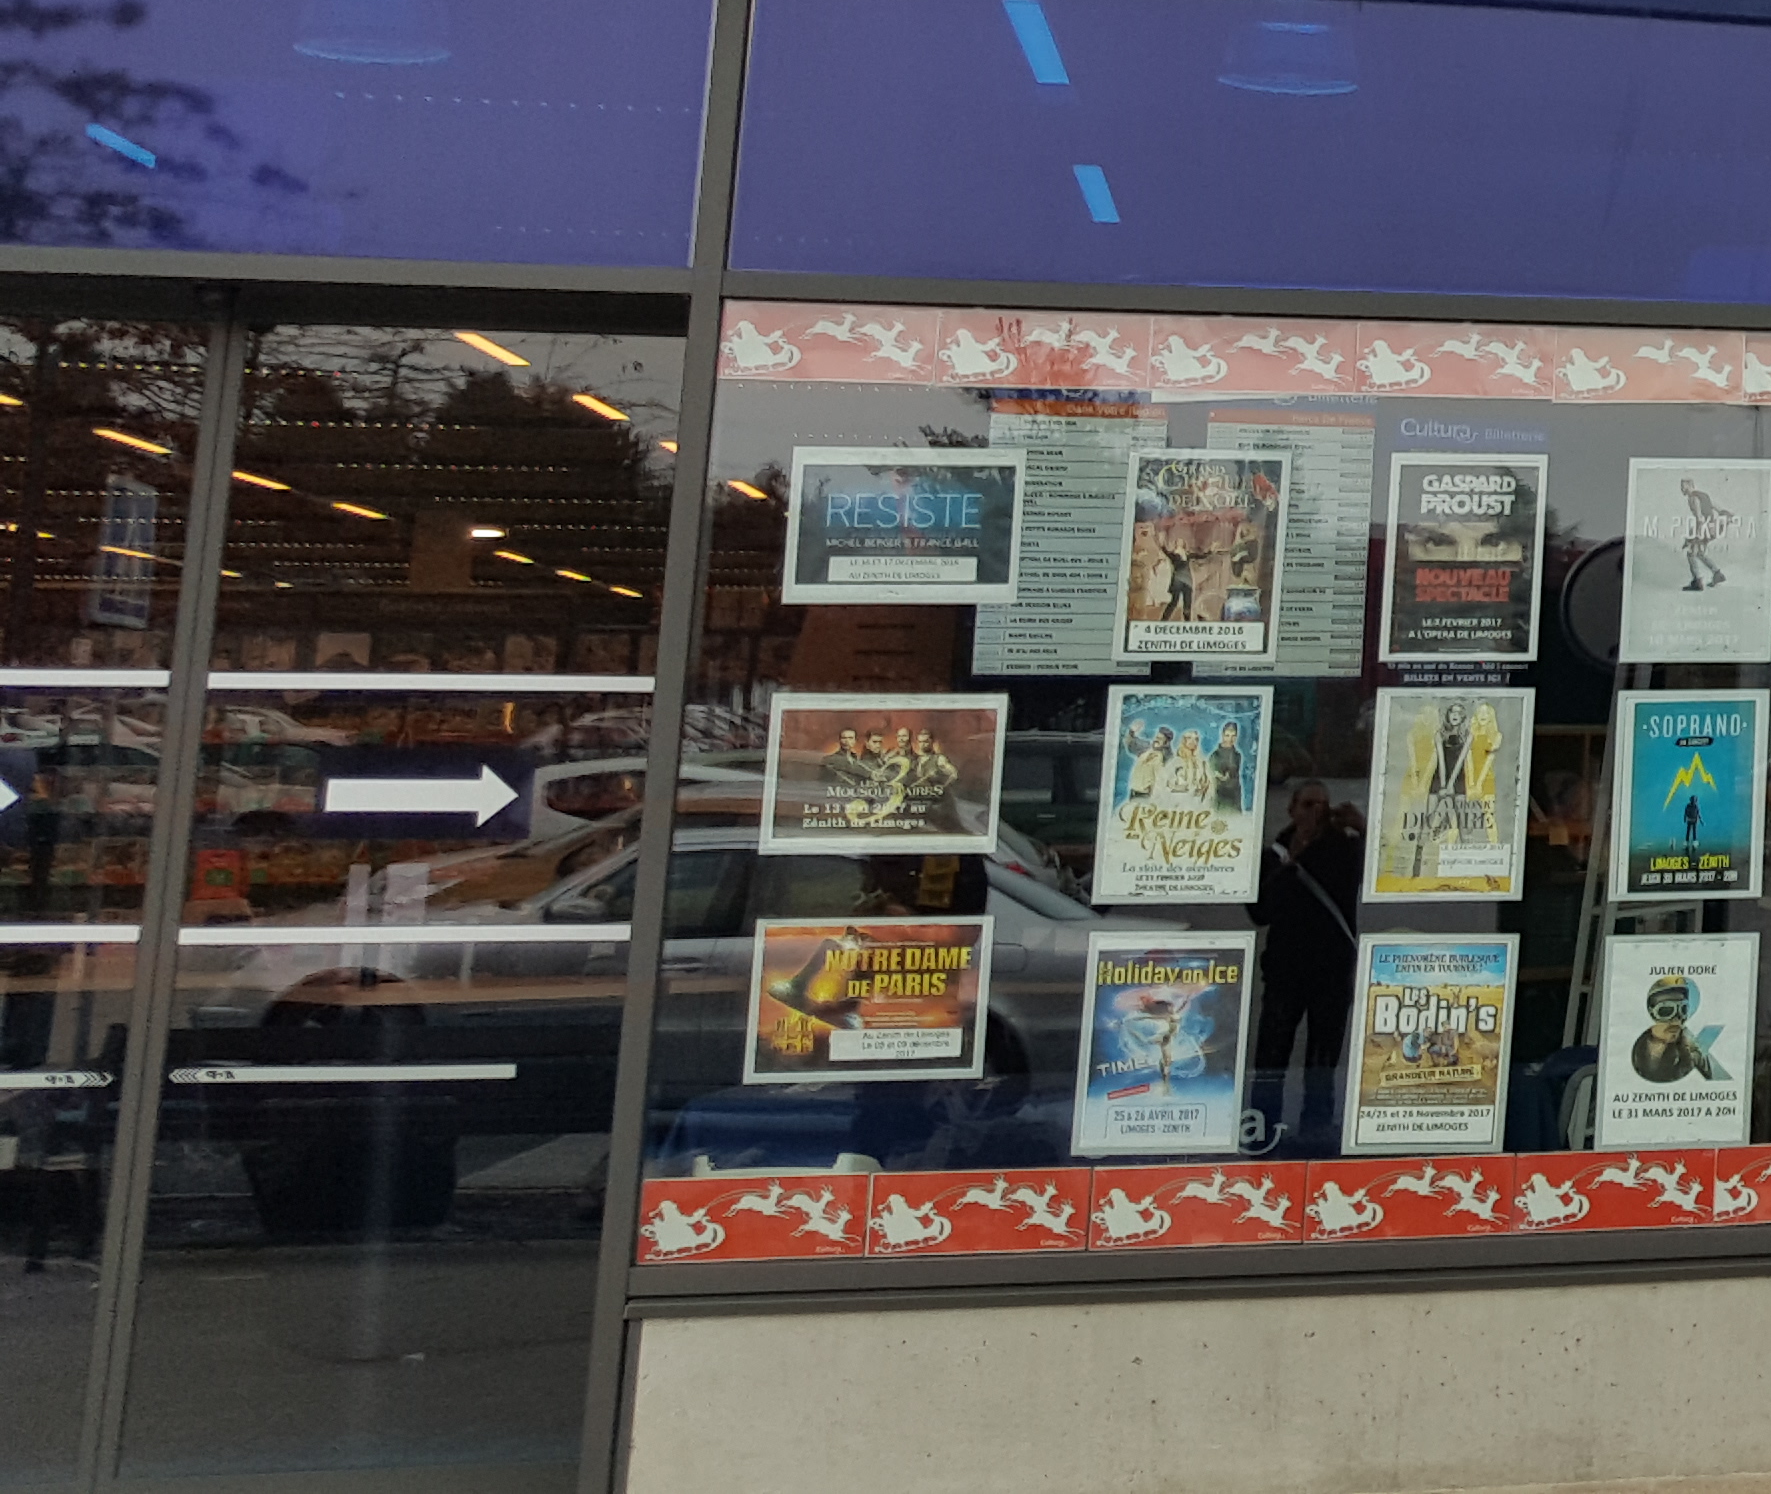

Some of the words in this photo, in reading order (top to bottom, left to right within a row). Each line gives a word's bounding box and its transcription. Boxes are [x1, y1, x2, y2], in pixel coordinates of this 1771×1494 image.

[1401, 418, 1475, 443] Cultura
[1423, 474, 1516, 493] GASPARD
[826, 493, 984, 528] RESISTE
[1421, 494, 1516, 516] PROUST
[1415, 568, 1512, 586] NOUVEAU
[1415, 586, 1510, 602] SPECTACLE
[1154, 624, 1214, 635] DECEMBRE
[1180, 640, 1194, 650] DE
[1197, 639, 1247, 650] LIMOGES
[1649, 713, 1741, 738] SOPRANO
[826, 785, 944, 798] MOUSQUAIRES
[1118, 803, 1212, 831] Reine
[1141, 831, 1243, 865] Neiges
[826, 949, 901, 972] NOTRE
[905, 947, 972, 970] DAME
[1098, 960, 1180, 986] Holiday
[1182, 969, 1201, 985] on
[1208, 960, 1239, 985] Ice
[1649, 966, 1684, 975] JULIEN
[848, 980, 870, 998] DE
[874, 973, 947, 996] PARIS
[1374, 994, 1497, 1034] Bodin's
[1385, 1070, 1436, 1081] GRANDEUR
[1613, 1093, 1629, 1103] AU
[1632, 1093, 1670, 1102] ZENITH
[1673, 1092, 1686, 1101] DE
[1690, 1091, 1737, 1102] LIMOGES
[1147, 1109, 1175, 1121] AVRIL
[1178, 1109, 1199, 1120] 2017
[1468, 1108, 1491, 1118] 2017
[1612, 1109, 1625, 1119] LE
[1627, 1108, 1638, 1118] 31
[1643, 1108, 1674, 1118] MARS
[1677, 1107, 1701, 1118] 2017
[1705, 1108, 1713, 1117] A
[1412, 1122, 1424, 1131] DE
[1426, 1122, 1469, 1131] LIMOGES
